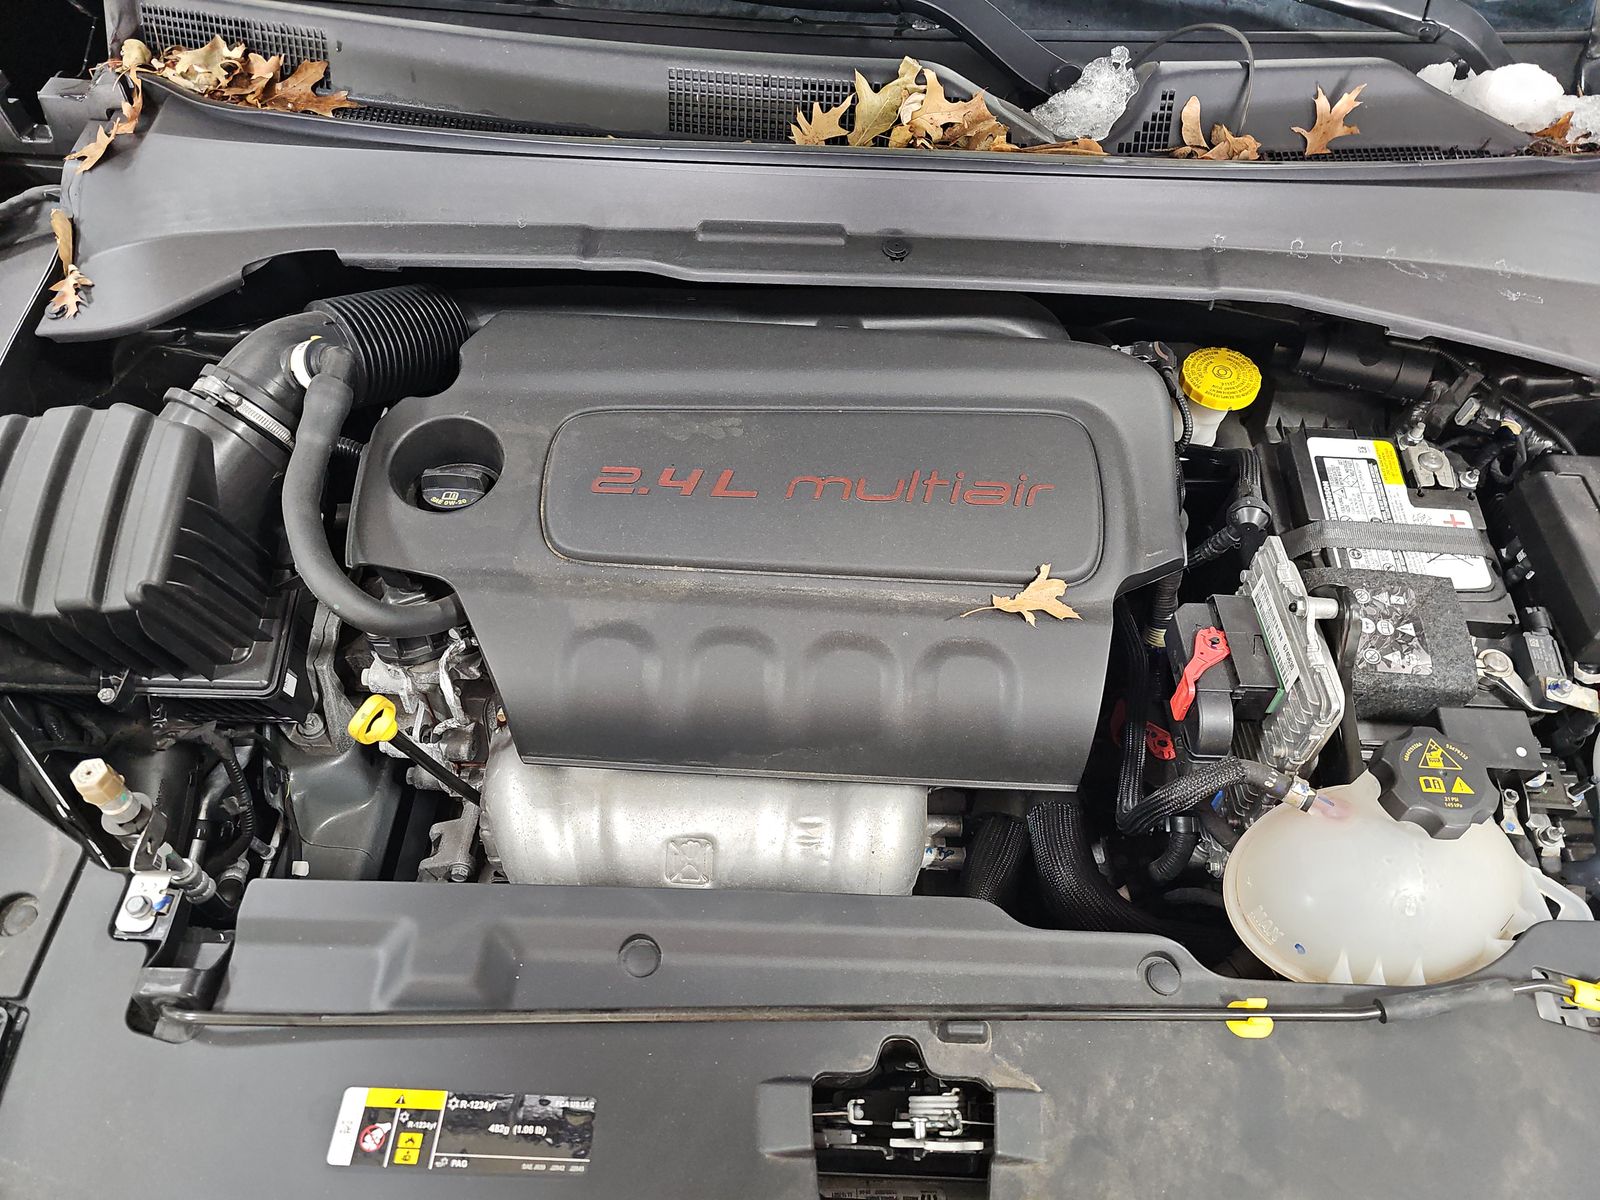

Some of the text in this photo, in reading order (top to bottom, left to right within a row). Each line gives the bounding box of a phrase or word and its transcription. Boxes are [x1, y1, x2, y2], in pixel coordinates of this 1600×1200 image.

[784, 469, 1056, 508] multiair
[444, 498, 467, 506] 0W-20
[459, 1100, 498, 1112] R-1234yf
